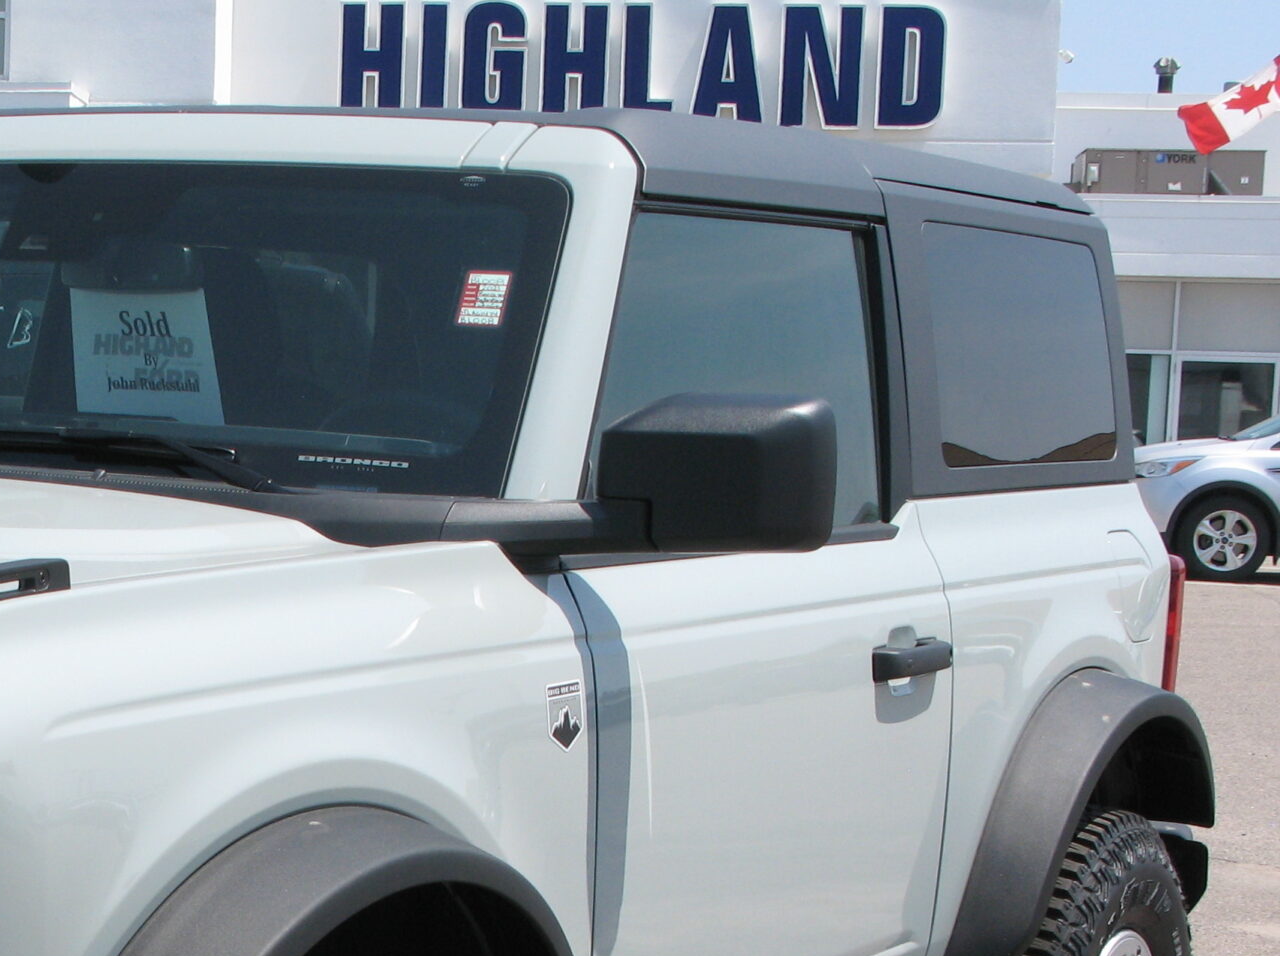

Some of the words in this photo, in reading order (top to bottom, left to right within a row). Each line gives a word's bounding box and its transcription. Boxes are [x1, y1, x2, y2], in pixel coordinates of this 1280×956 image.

[340, 1, 948, 130] HIGHLAND
[1166, 153, 1197, 164] YORK
[118, 310, 172, 338] Sold
[143, 353, 159, 369] By
[107, 376, 138, 393] John
[298, 454, 410, 469] BRONCO
